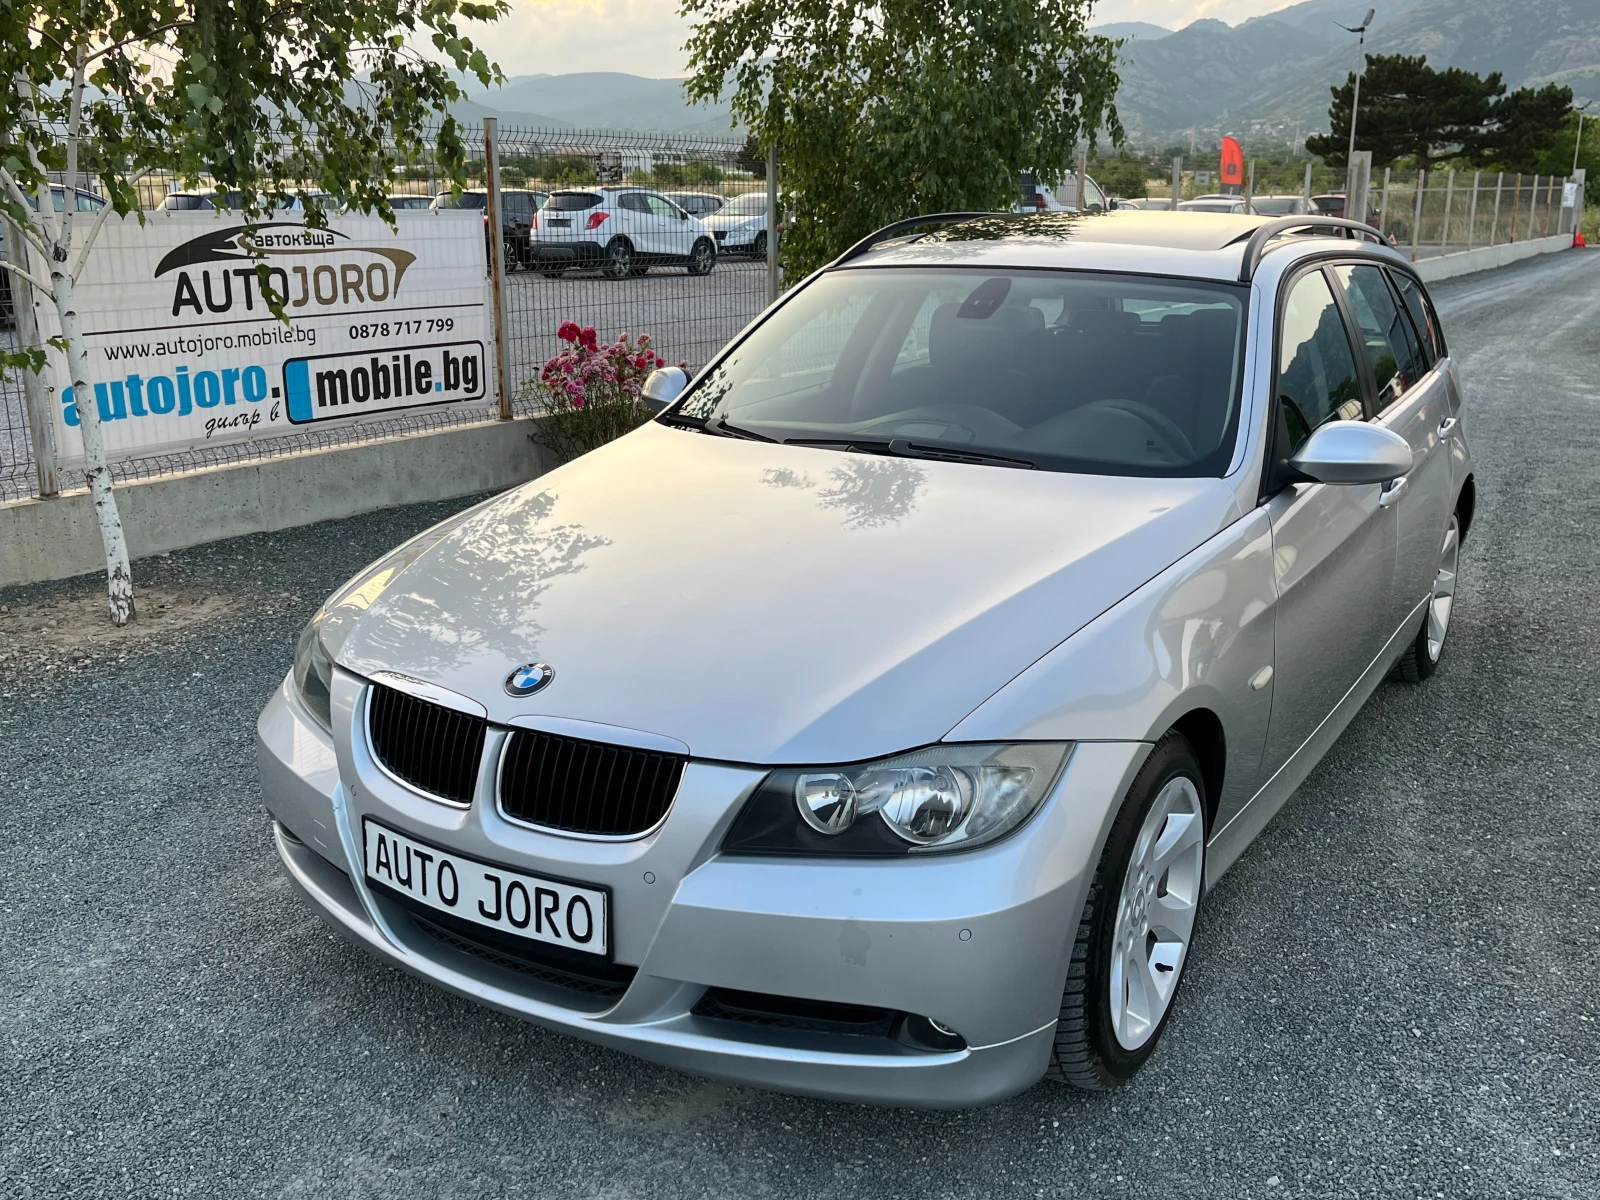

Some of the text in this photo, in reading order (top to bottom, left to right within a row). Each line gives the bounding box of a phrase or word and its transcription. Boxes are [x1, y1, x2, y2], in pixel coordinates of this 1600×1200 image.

[254, 233, 335, 247] автокъща
[104, 324, 316, 361] www.autojoro.mobile.bg
[349, 317, 455, 340] 0878 717 799
[316, 350, 479, 408] mobile.bg
[375, 832, 593, 944] AUTO JORO
